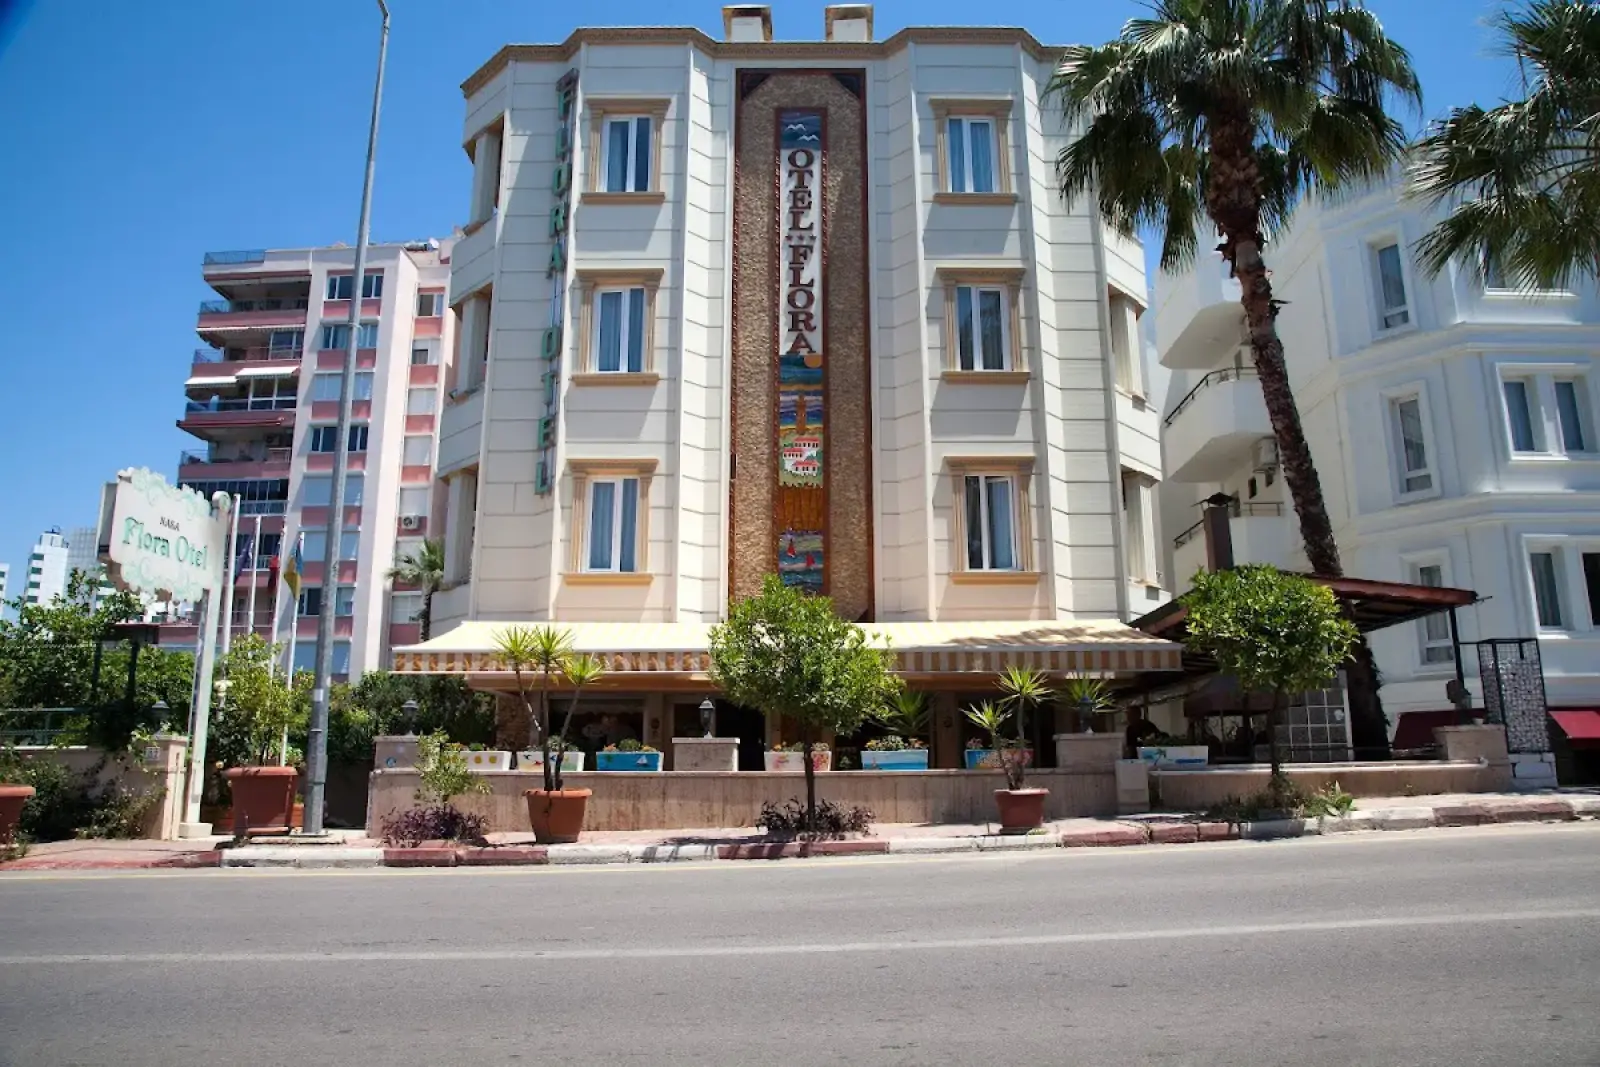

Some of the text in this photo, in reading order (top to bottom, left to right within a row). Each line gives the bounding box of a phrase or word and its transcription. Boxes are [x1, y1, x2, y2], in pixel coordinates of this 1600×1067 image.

[535, 88, 574, 497] FLORA OTEL
[786, 148, 817, 355] OTEL FLORA
[122, 517, 208, 570] Flora Otel
